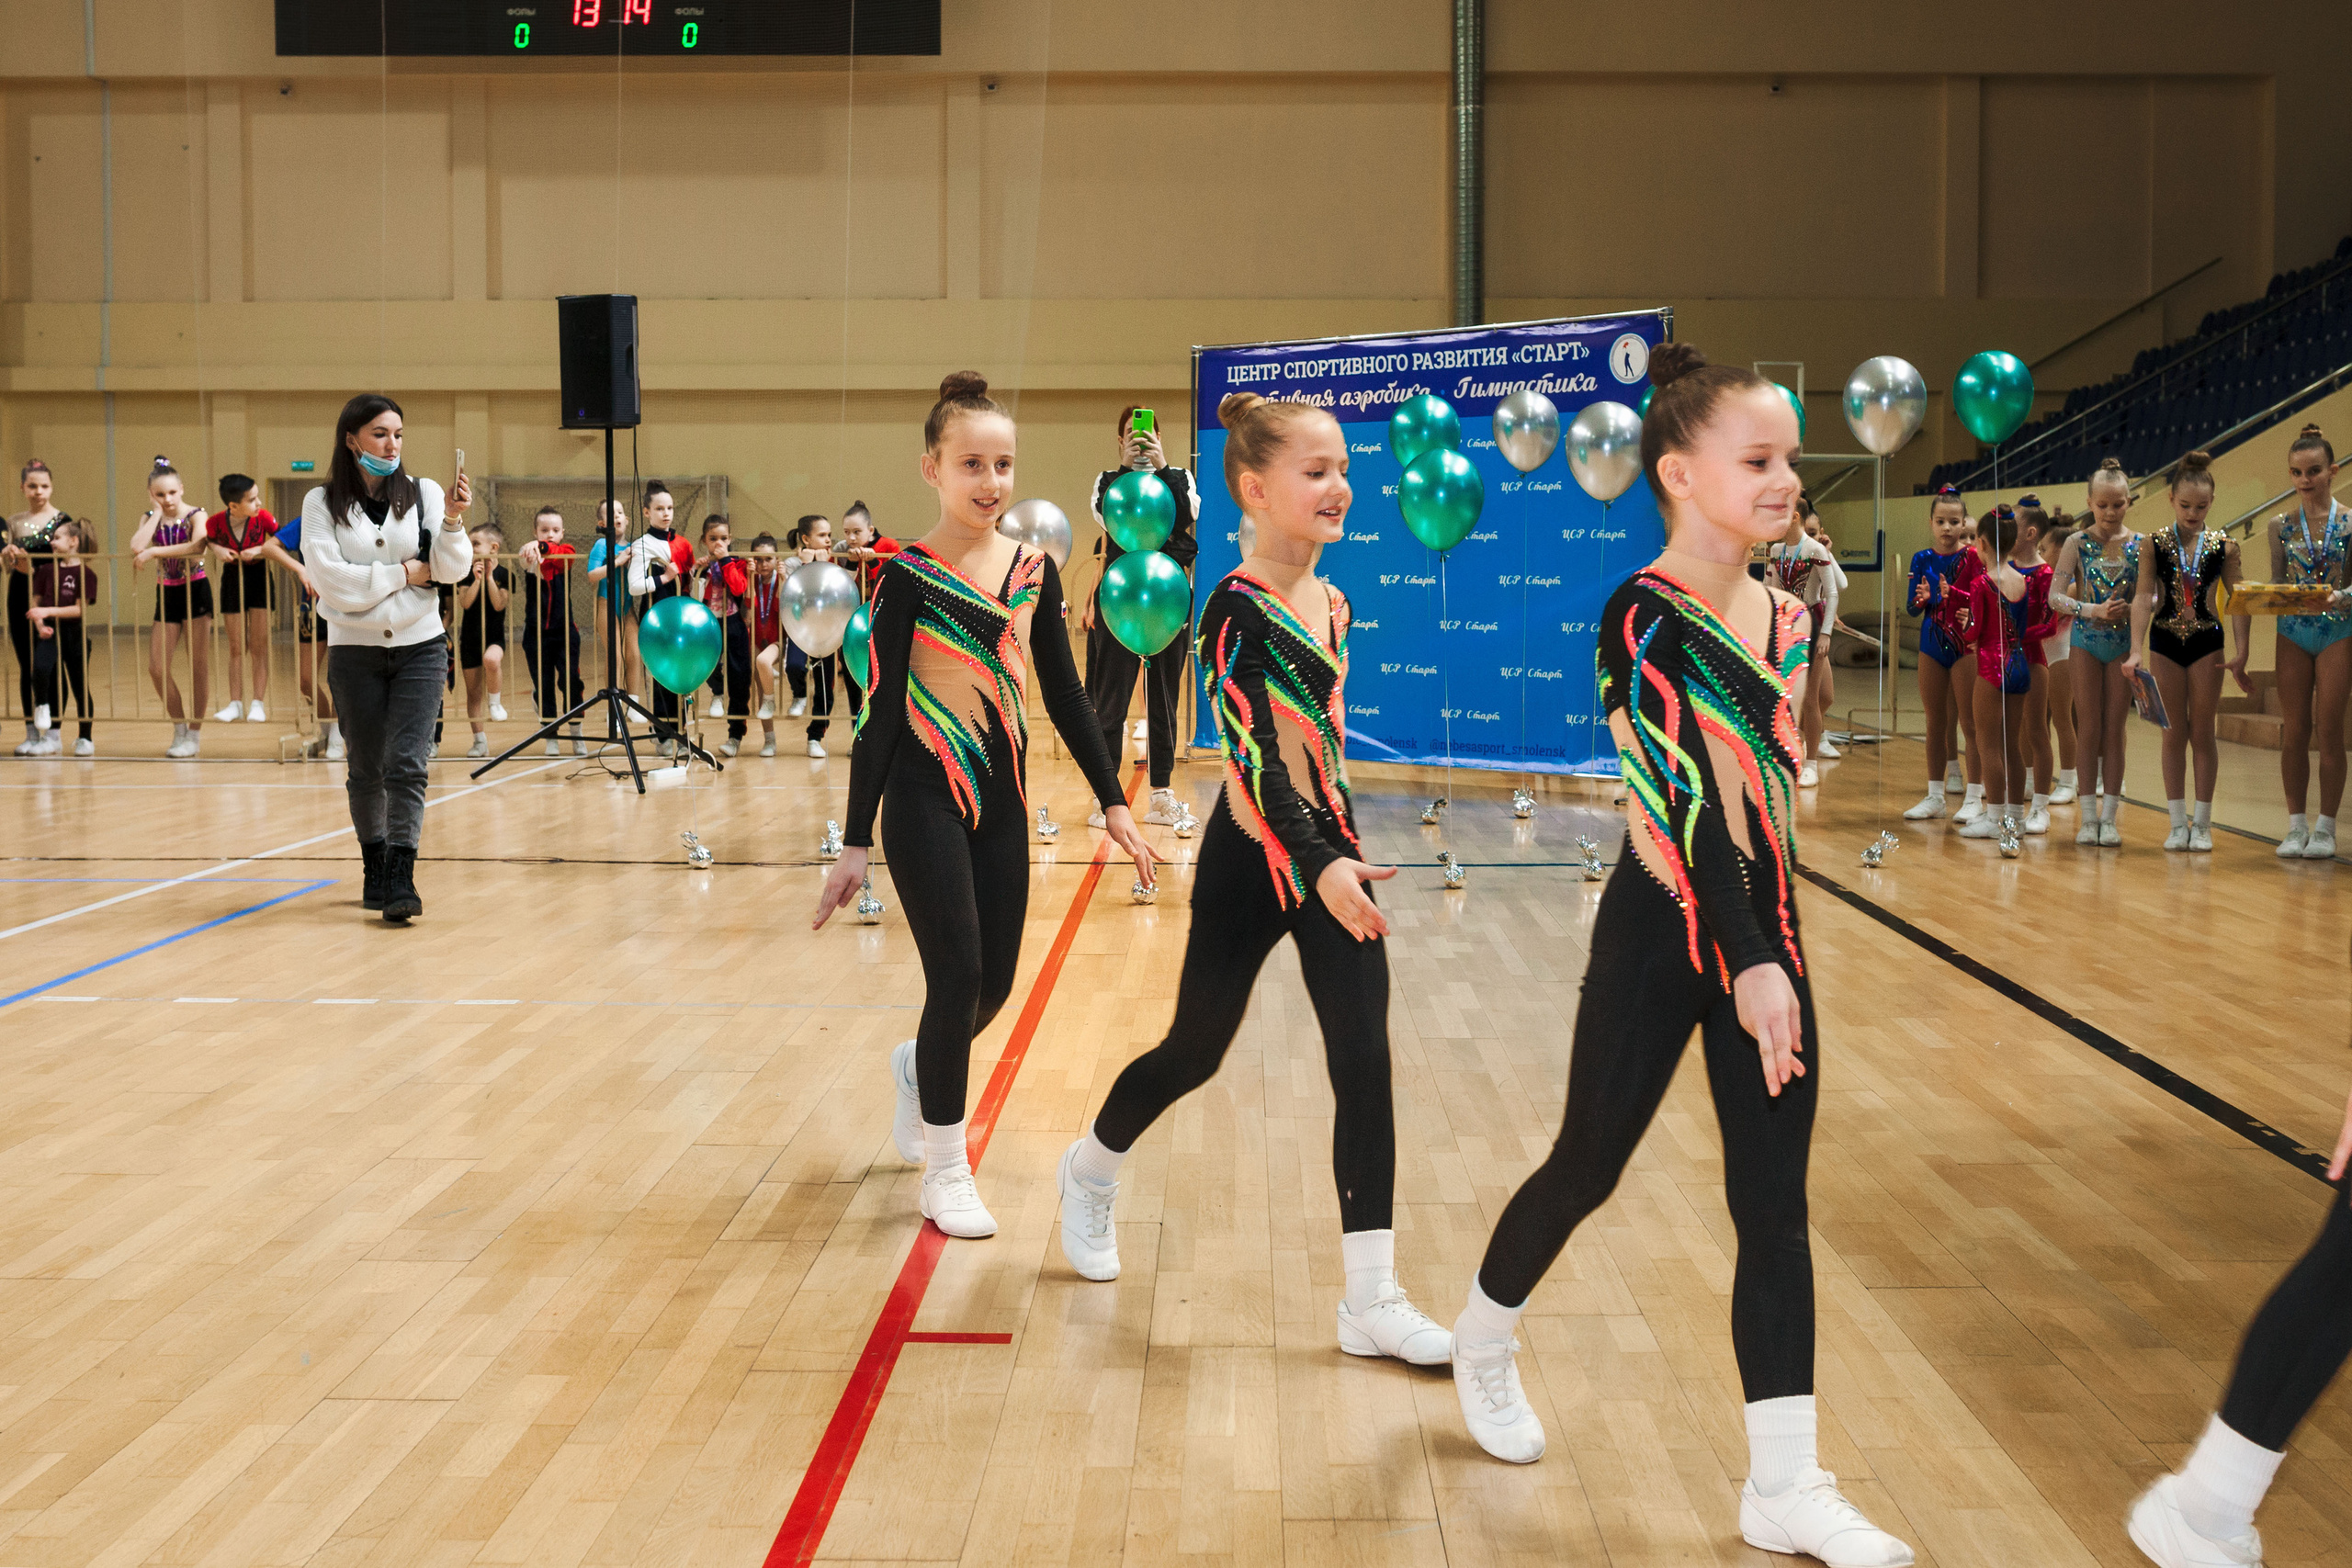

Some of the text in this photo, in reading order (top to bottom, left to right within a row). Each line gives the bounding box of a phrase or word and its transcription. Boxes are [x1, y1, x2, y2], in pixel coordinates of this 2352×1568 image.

[572, 0, 651, 27] 13 14
[514, 23, 530, 48] 0
[682, 22, 698, 48] 0
[1227, 342, 1590, 386] ЦЕНТР СПОРТИВНОГО РАЗВИТИЯ «СТАРТ»
[1453, 372, 1598, 399] Гимнастика
[1351, 443, 1382, 455] Старт
[1500, 481, 1562, 494] ЦСР Старт
[1349, 532, 1380, 544] Старт
[1562, 529, 1626, 542] ЦСР Старт
[1380, 574, 1436, 587] ЦСР Старт
[1498, 575, 1561, 588] ЦСР Старт
[1439, 620, 1498, 633] ЦСР Старт
[1561, 622, 1585, 635] ЦСР
[1381, 663, 1437, 677] ЦСР Старт
[1500, 667, 1563, 681] ЦСР Старт
[1349, 705, 1380, 716] Старт
[1440, 708, 1499, 723] ЦСР Старт
[1565, 714, 1588, 727] ЦСР
